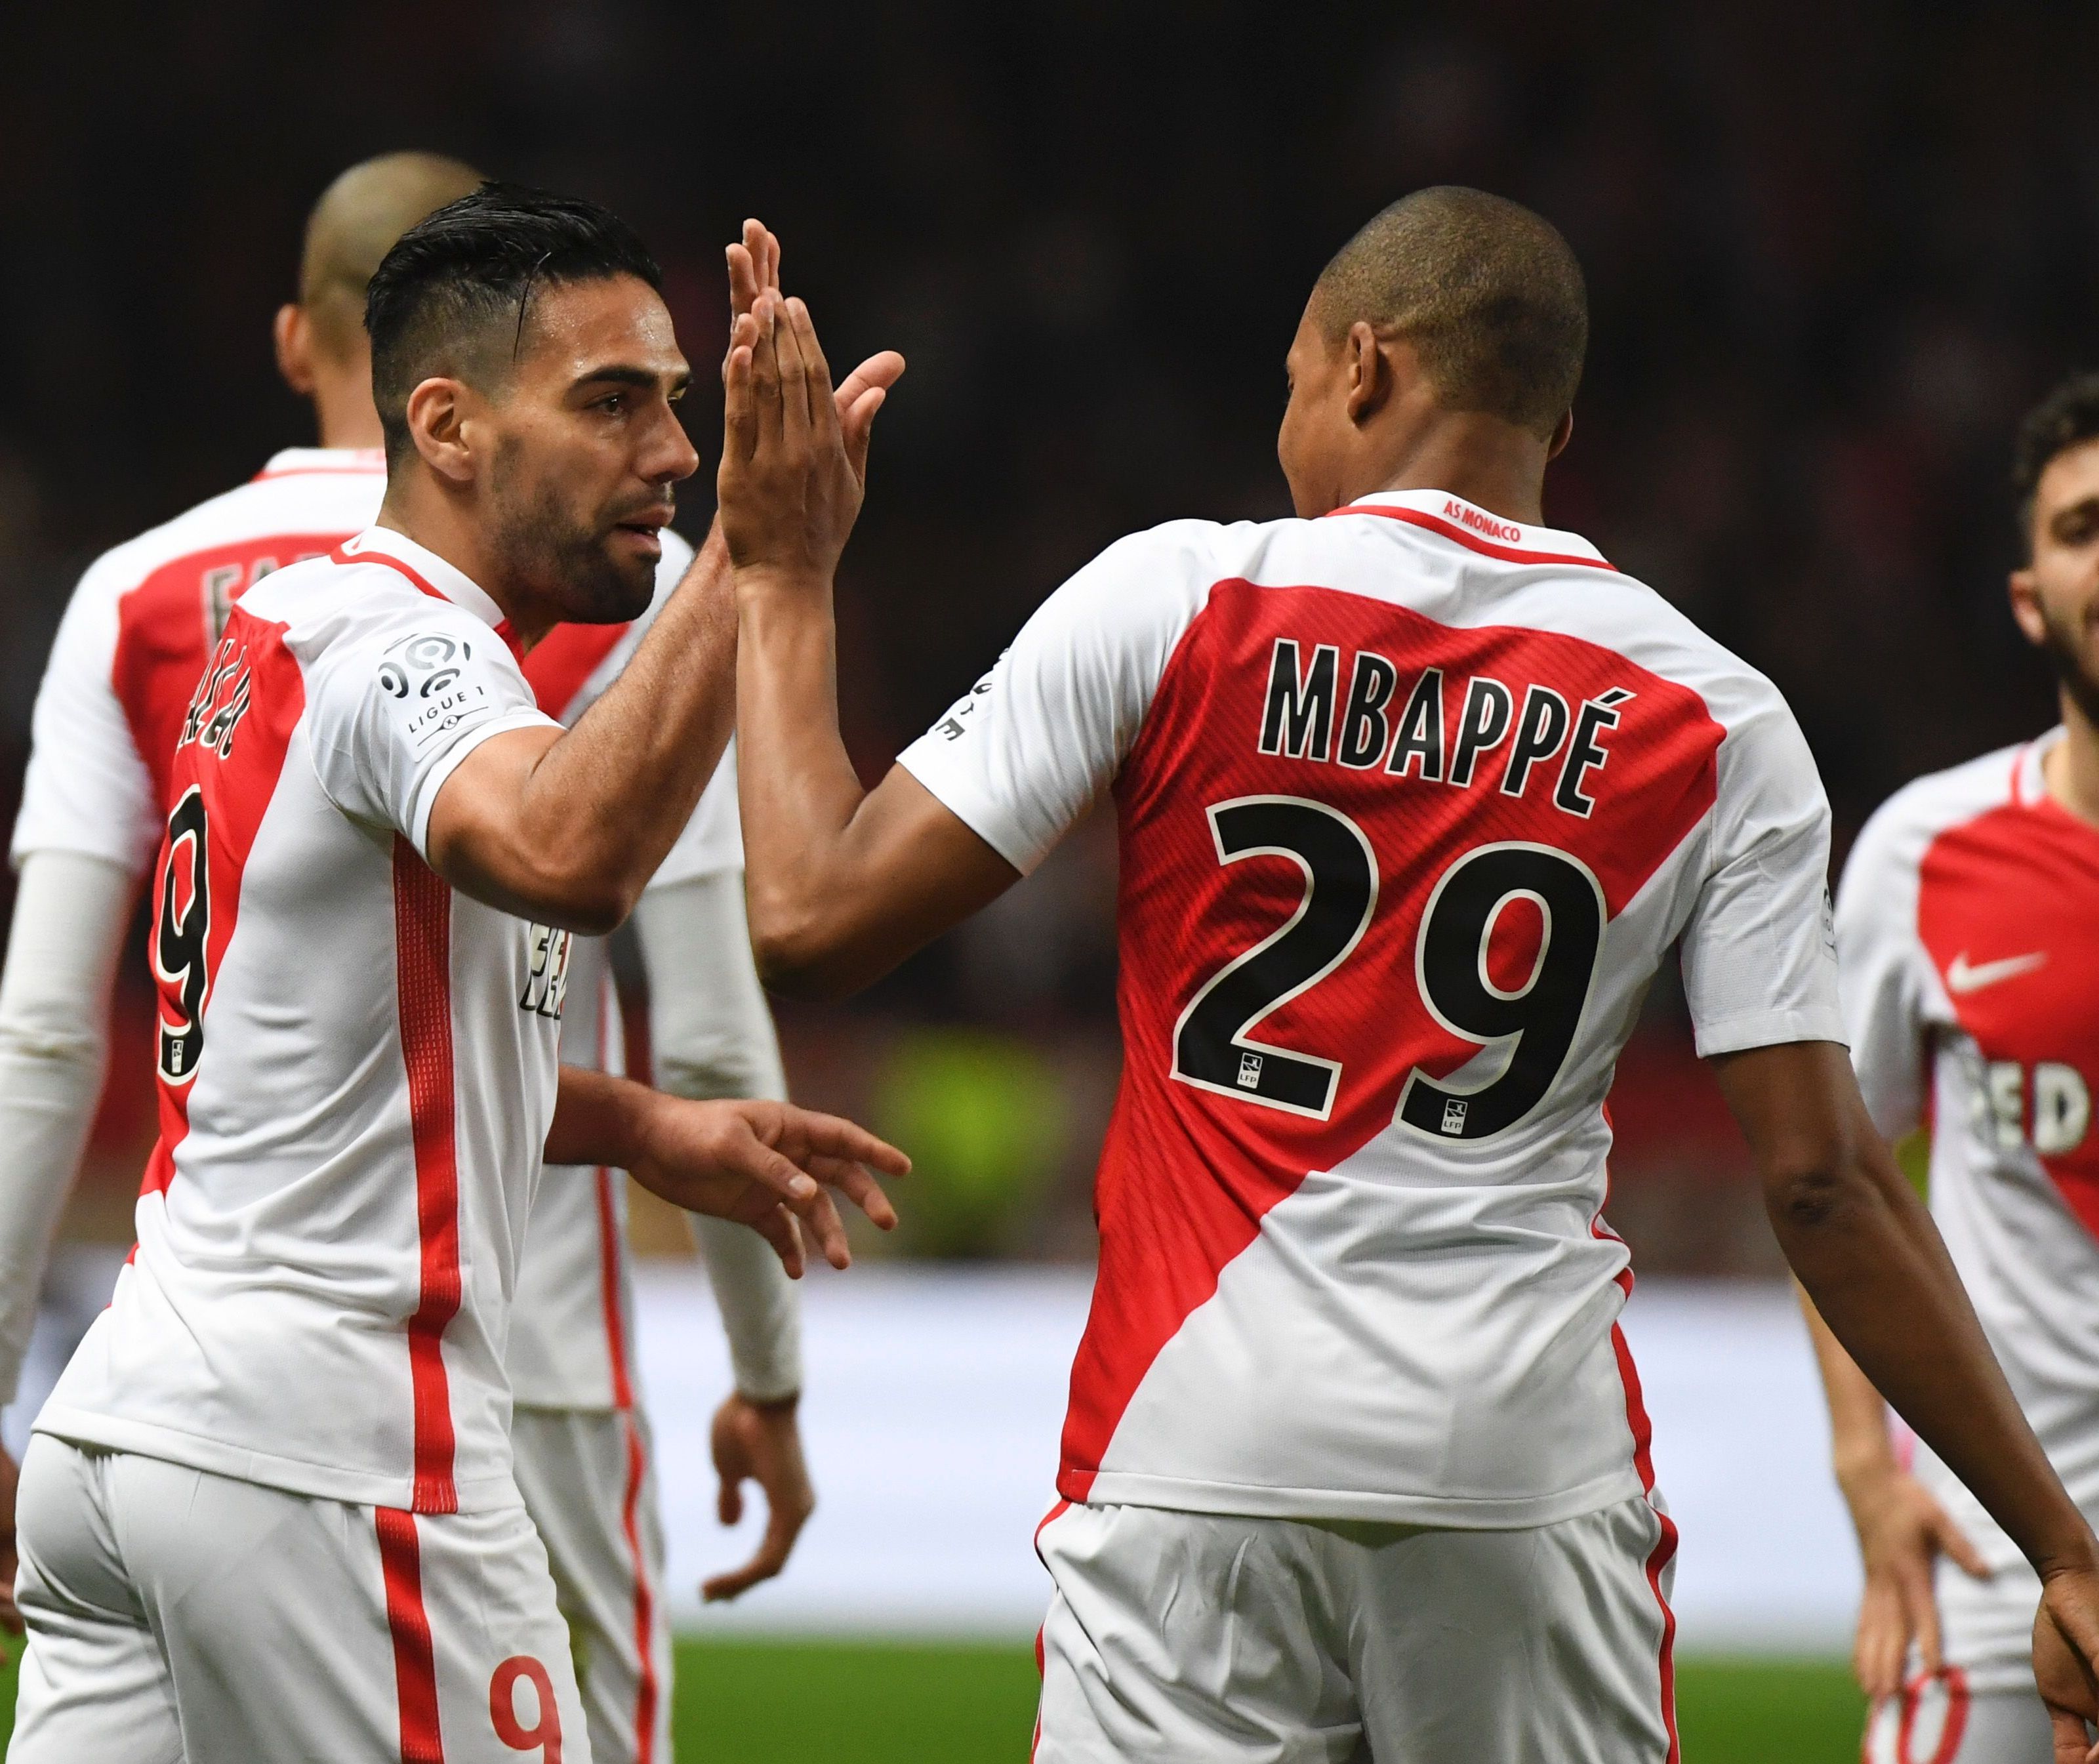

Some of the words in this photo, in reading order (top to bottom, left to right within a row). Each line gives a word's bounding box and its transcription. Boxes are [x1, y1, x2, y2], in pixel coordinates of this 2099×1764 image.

[1443, 500, 1461, 518] AS
[1461, 507, 1521, 543] MONACO
[408, 691, 467, 733] LIGUE
[476, 686, 484, 695] 1
[1257, 637, 1638, 819] MBAPPÉ
[156, 783, 210, 1086] 9
[1170, 794, 1608, 1146] 29
[1240, 1074, 1257, 1083] LFP
[1444, 1120, 1462, 1129] LFP
[489, 1654, 562, 1764] 9
